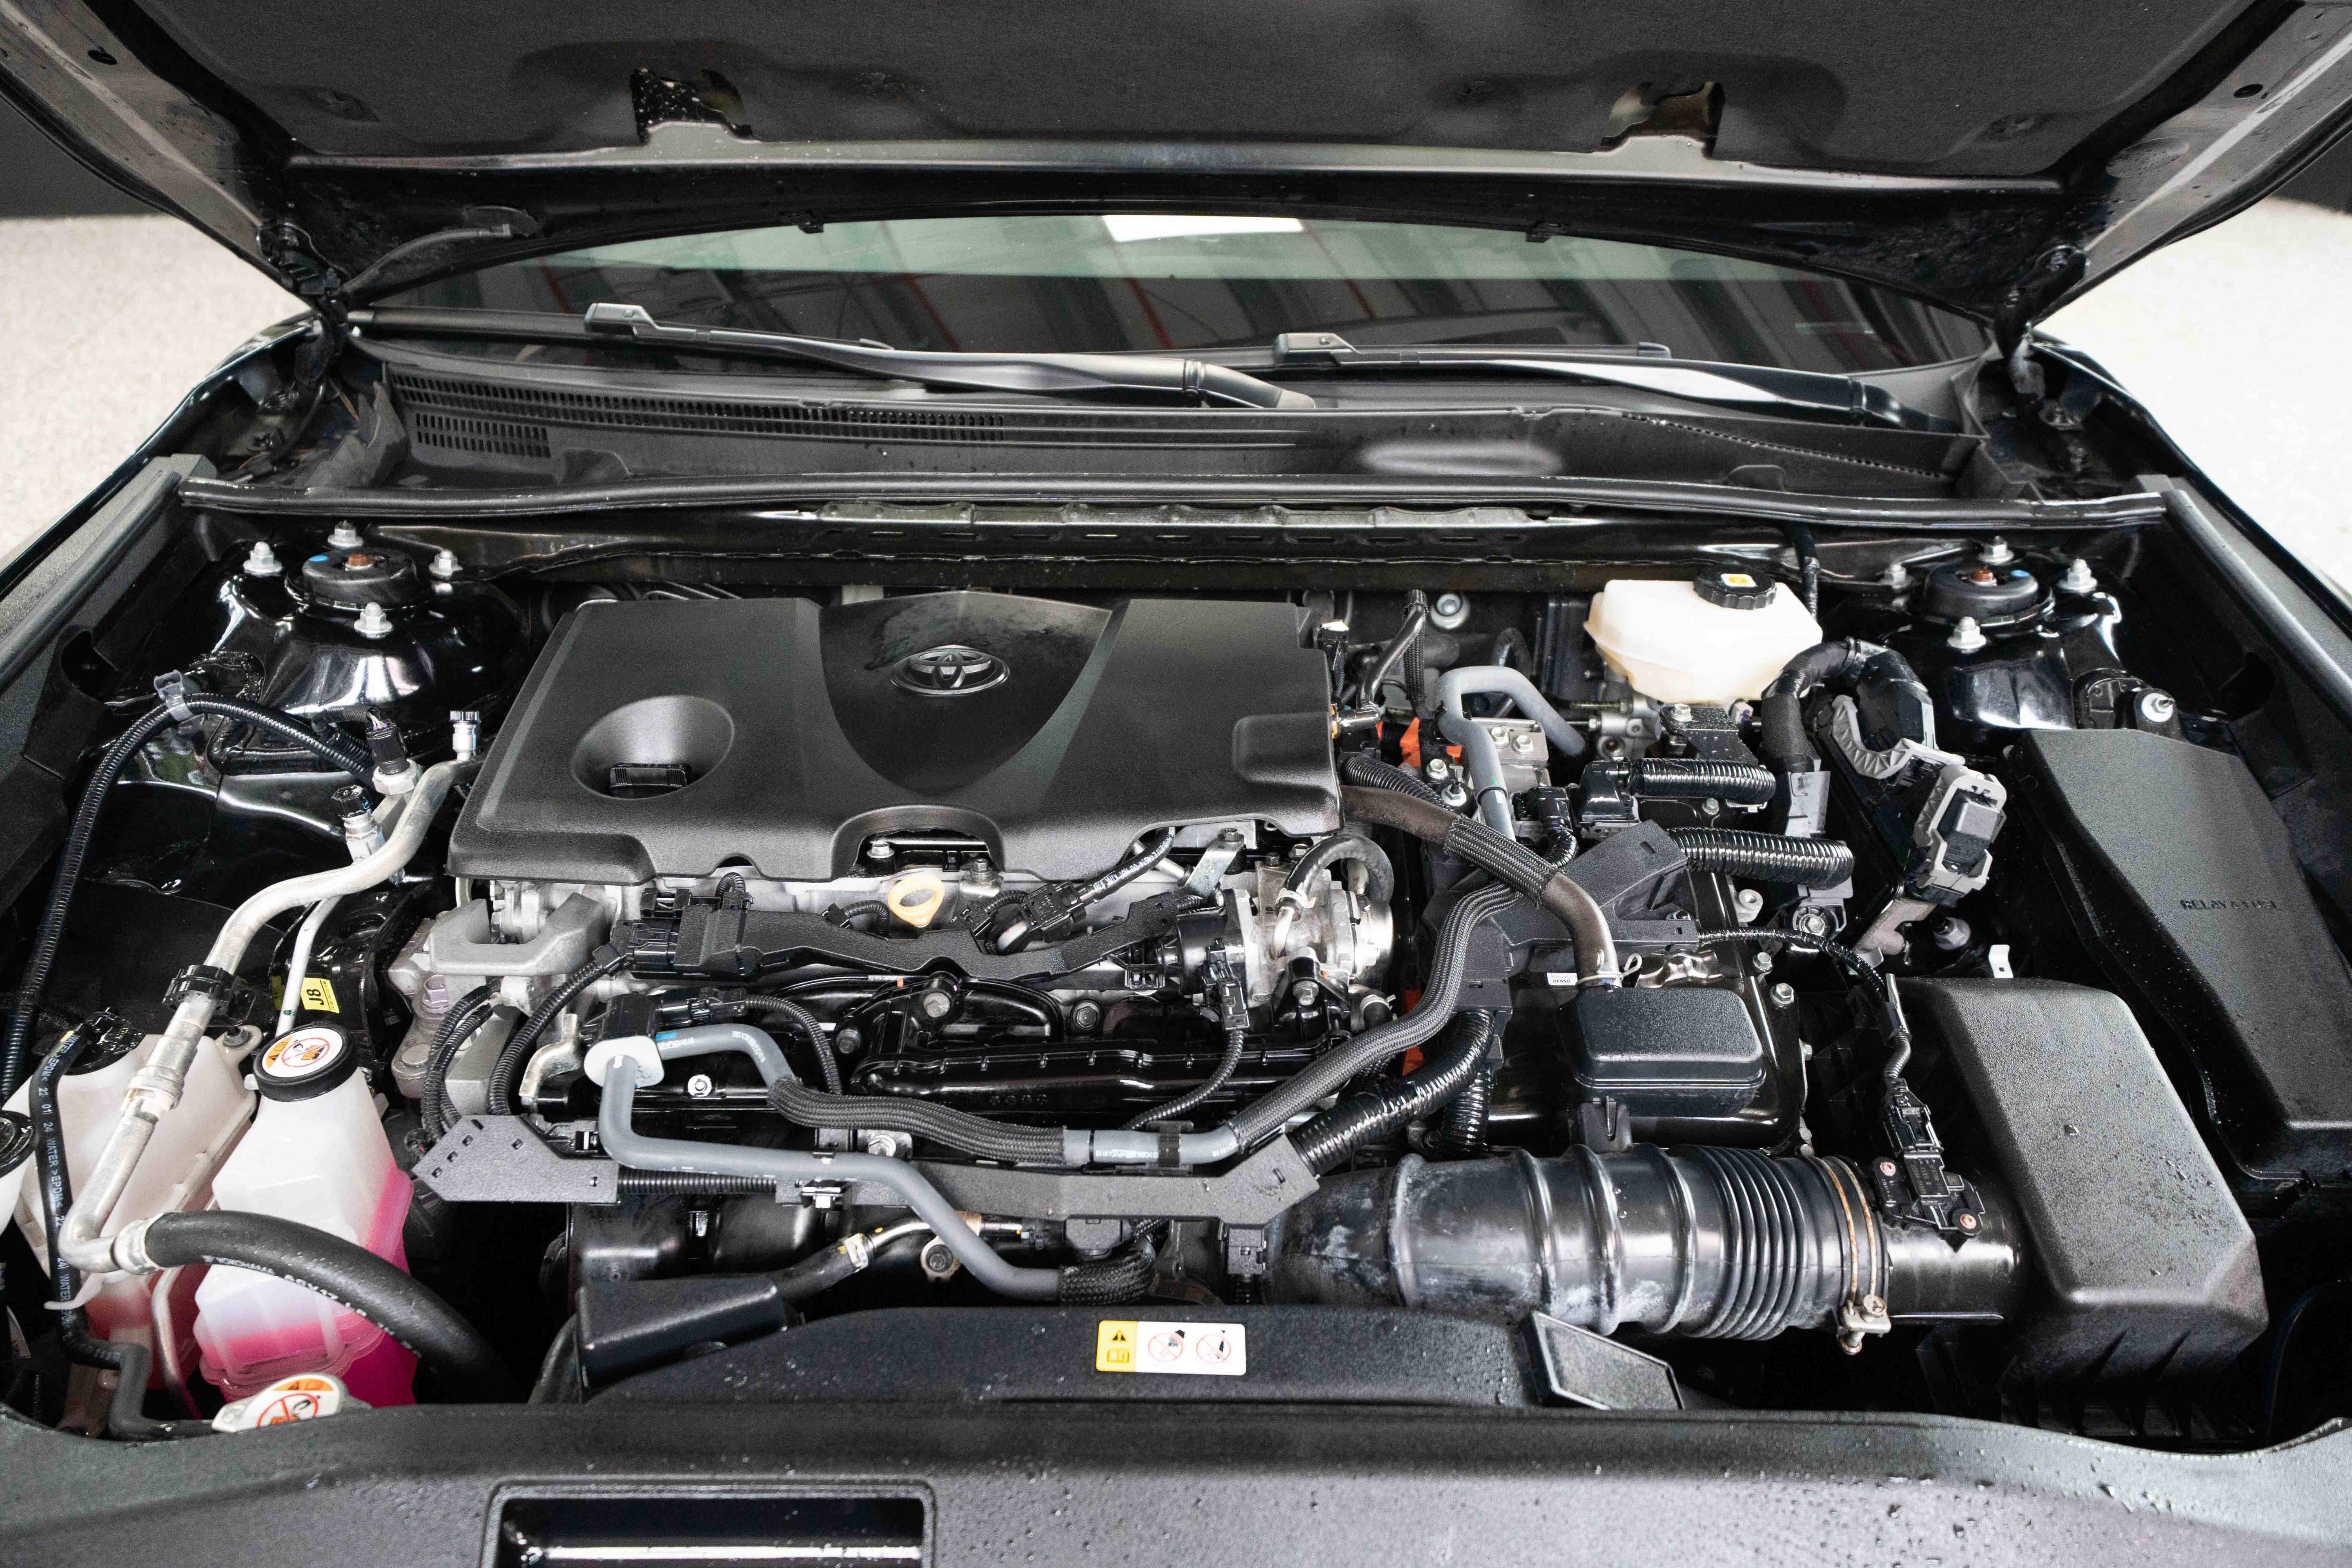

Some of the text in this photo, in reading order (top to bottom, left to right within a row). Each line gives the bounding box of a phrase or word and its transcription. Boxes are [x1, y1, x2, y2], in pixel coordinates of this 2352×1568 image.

[2180, 900, 2226, 909] RELAY
[306, 988, 324, 1005] J8
[60, 1033, 80, 1054] WATER
[46, 1137, 59, 1168] WATER
[60, 1273, 71, 1301] WATER
